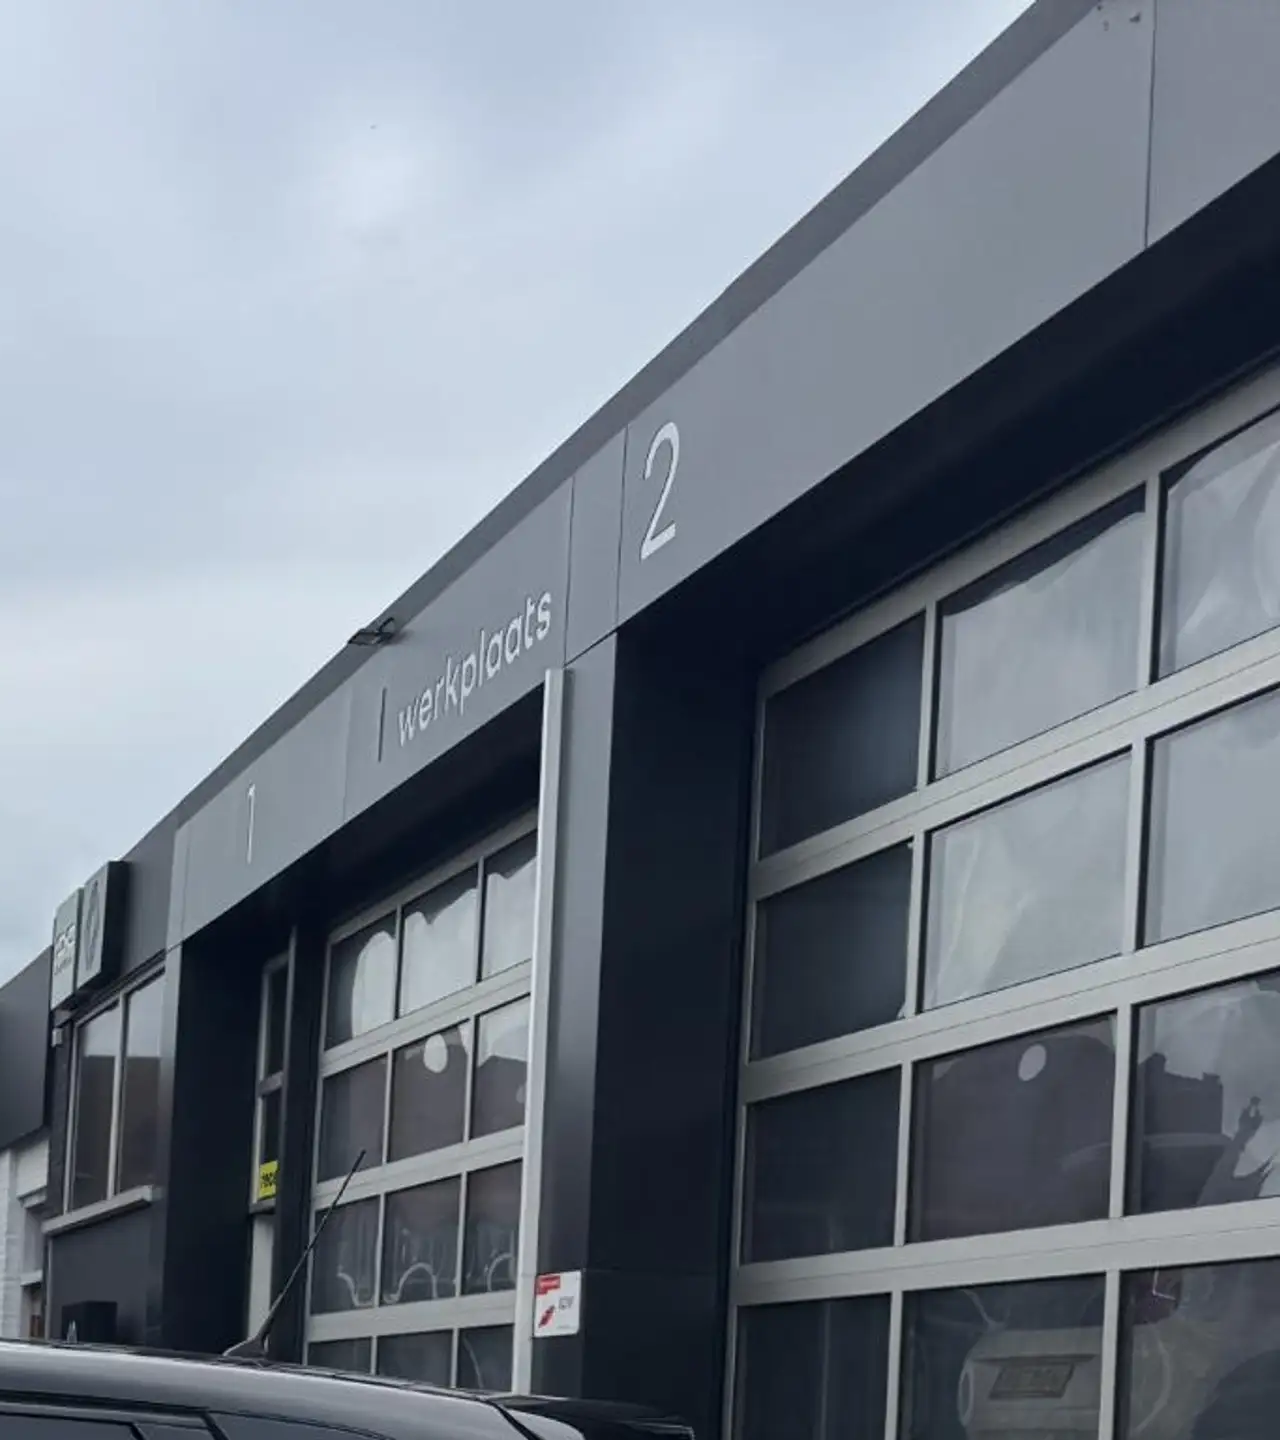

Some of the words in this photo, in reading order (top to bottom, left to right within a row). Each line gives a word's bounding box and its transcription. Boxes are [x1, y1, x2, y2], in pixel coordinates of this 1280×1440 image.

[640, 421, 680, 560] 2
[398, 592, 552, 747] werkplaats
[246, 782, 256, 865] 1
